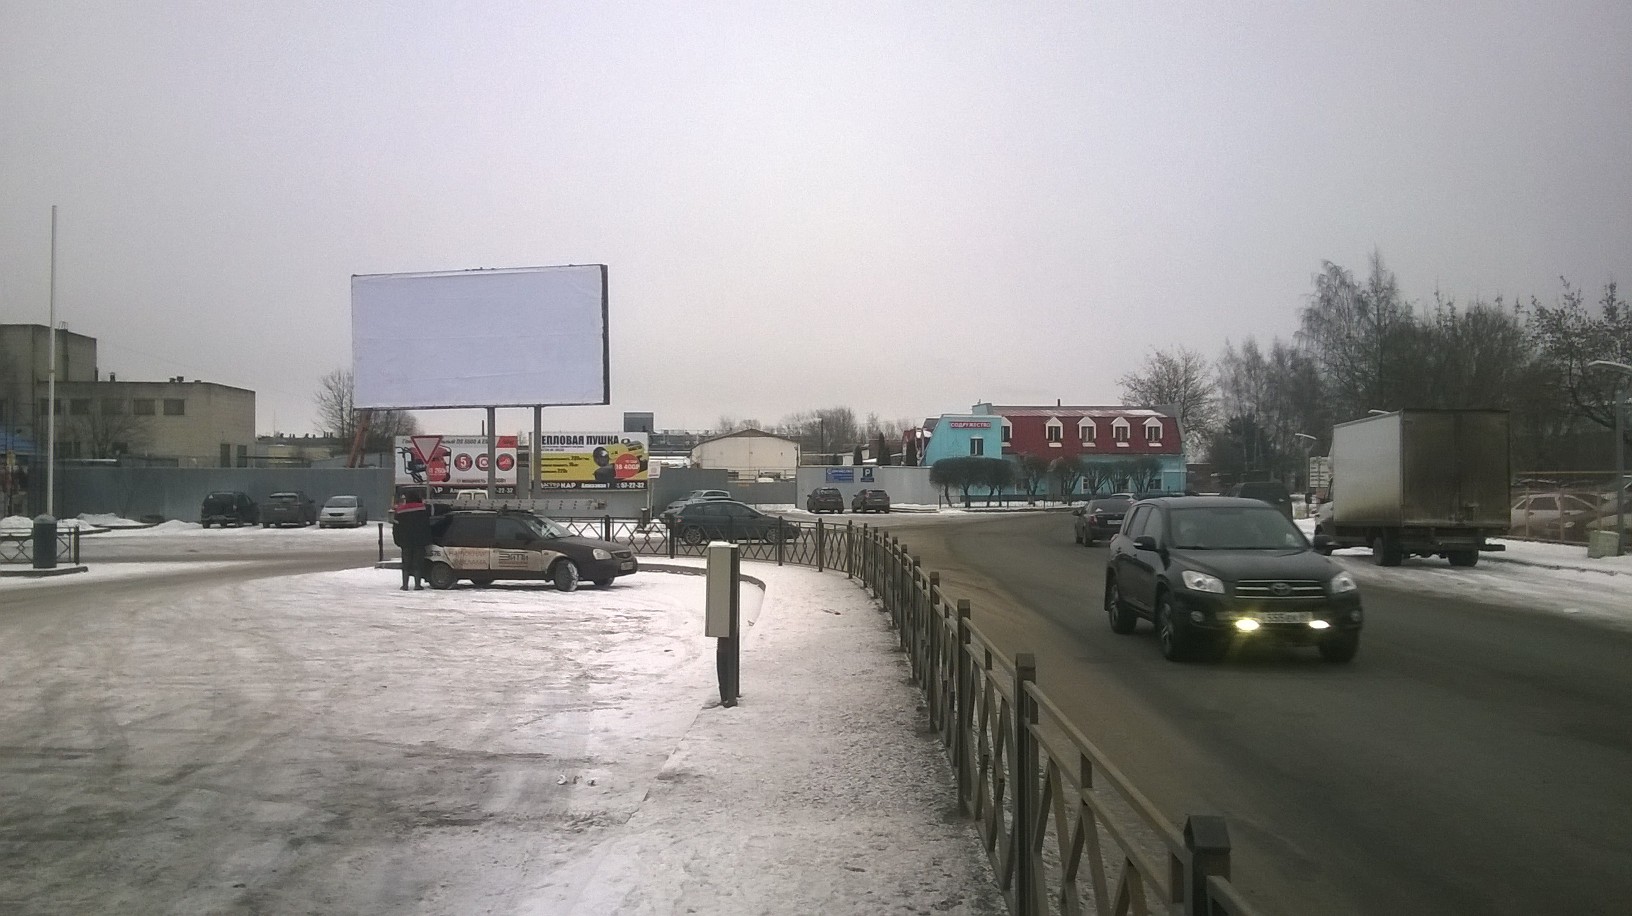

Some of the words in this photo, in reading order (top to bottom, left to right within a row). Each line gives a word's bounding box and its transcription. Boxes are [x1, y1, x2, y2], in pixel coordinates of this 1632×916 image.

[541, 435, 584, 446] ЕПЛОВАЯ
[586, 435, 619, 445] ПУШКА
[460, 456, 467, 467] 5
